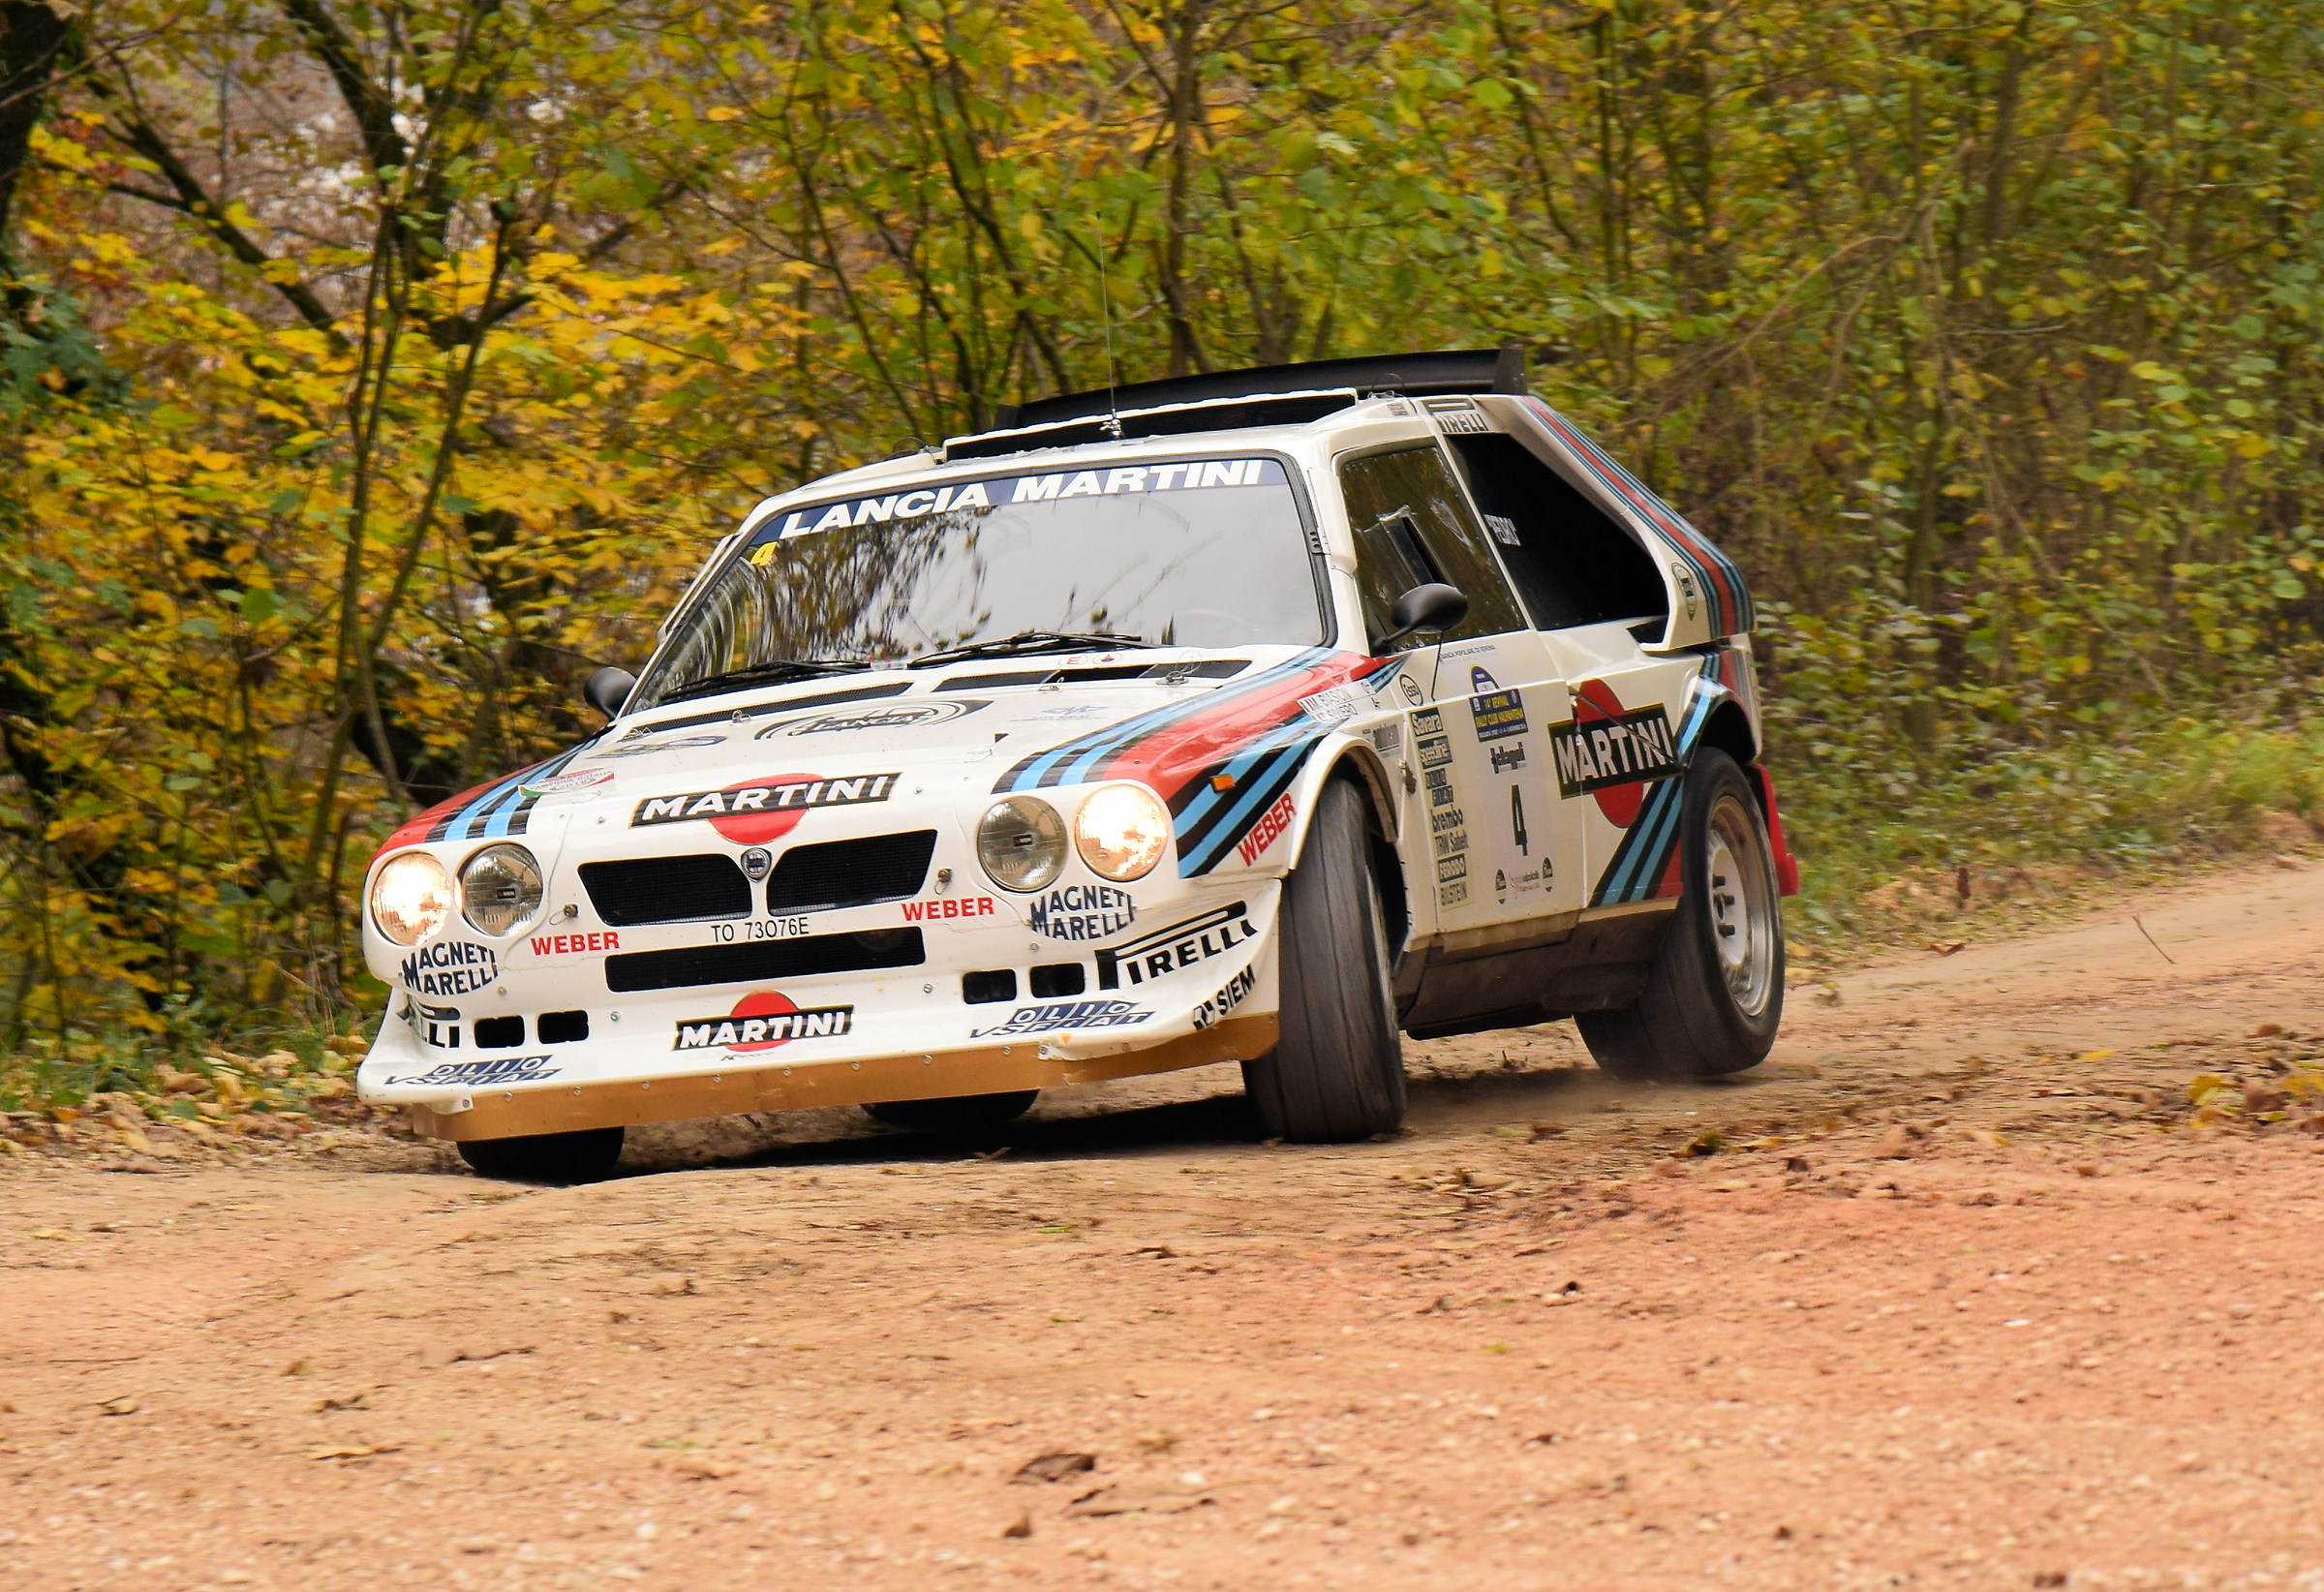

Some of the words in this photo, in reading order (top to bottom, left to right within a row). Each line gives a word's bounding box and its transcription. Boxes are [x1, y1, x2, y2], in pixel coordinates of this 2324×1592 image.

[779, 482, 990, 539] LANCIA
[1011, 459, 1263, 504] MARTINI
[750, 541, 777, 566] 4
[1403, 683, 1421, 698] Esso
[1555, 718, 1673, 784] MARTINI
[642, 776, 890, 821] MARTINI
[1238, 792, 1297, 867] WEBER
[1429, 804, 1464, 833] brembo
[1511, 784, 1528, 857] 4
[902, 897, 994, 921] WEBER
[1029, 884, 1135, 923] MAGNETI
[711, 924, 734, 942] TO
[1031, 909, 1136, 940] MARELLI
[401, 941, 498, 976] MAGNETI
[531, 932, 620, 956] WEBER
[1095, 901, 1259, 991] PIRELLI
[403, 966, 500, 995] MARELLI
[1216, 963, 1256, 1016] SIEM
[680, 1012, 844, 1049] MARTINI
[1011, 1001, 1134, 1025] OLIO
